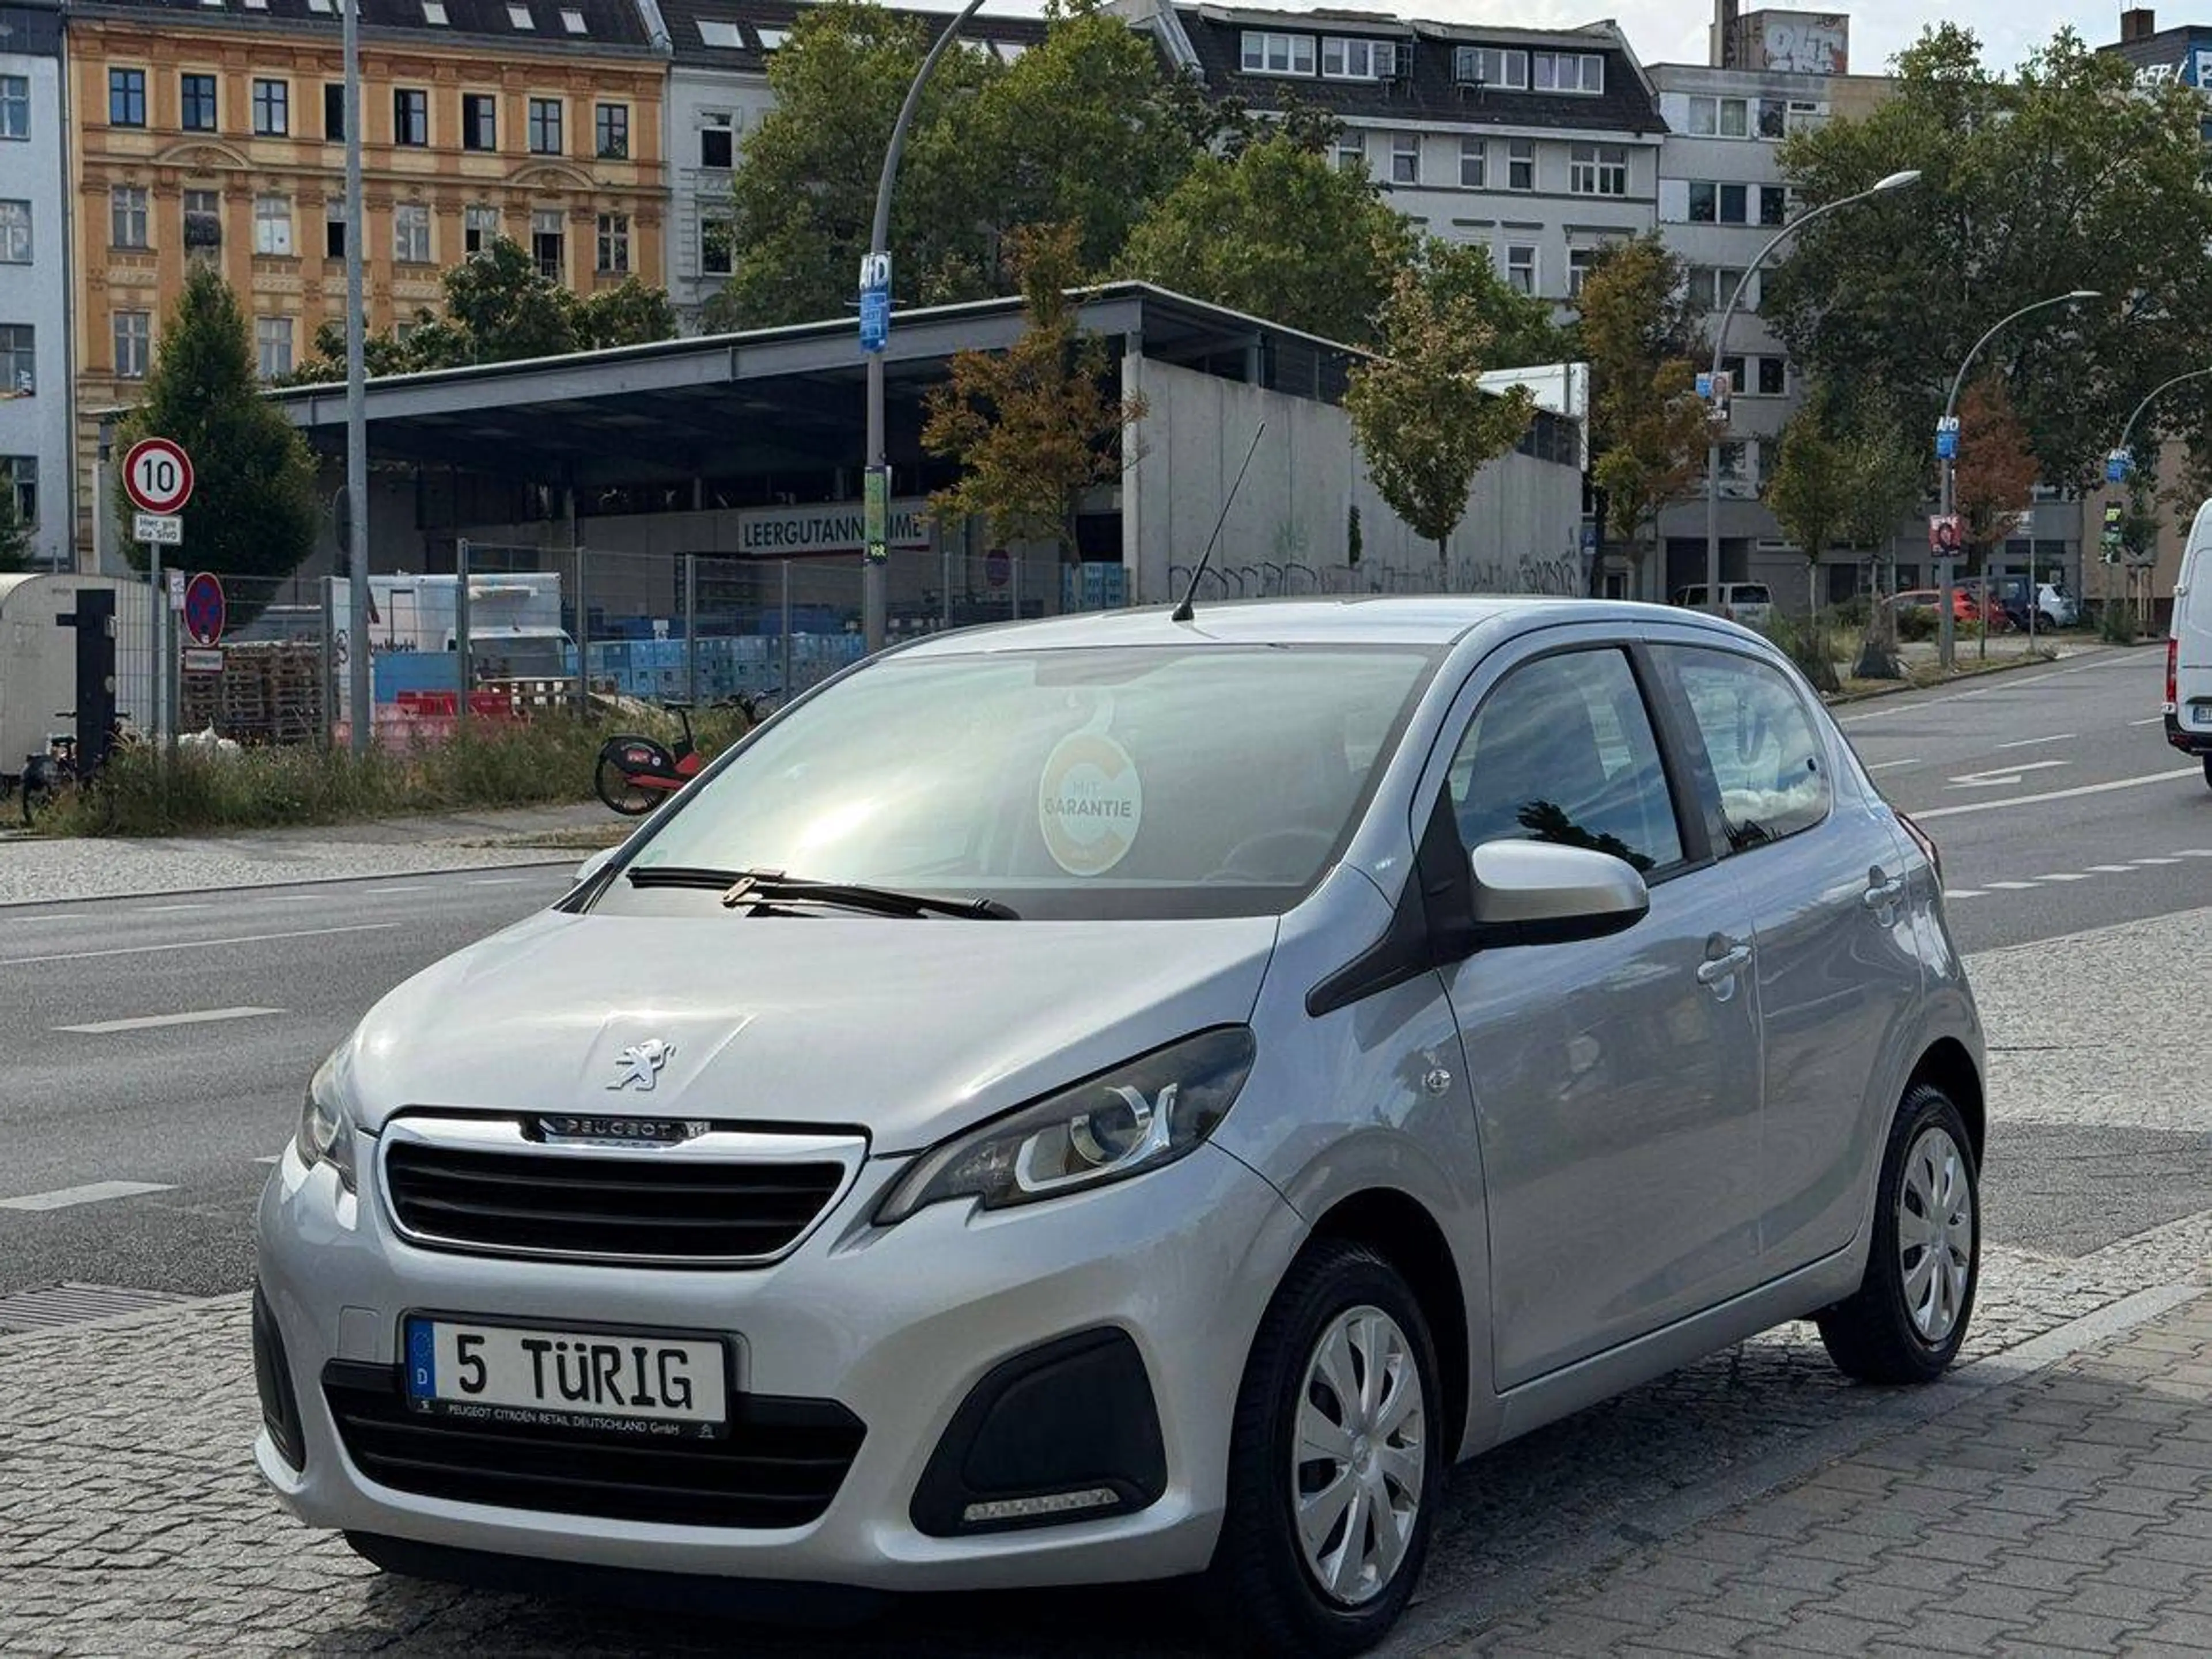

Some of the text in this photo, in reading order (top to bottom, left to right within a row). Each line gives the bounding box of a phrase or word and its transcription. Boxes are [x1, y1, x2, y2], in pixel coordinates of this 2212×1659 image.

[142, 459, 175, 493] 10
[744, 513, 922, 548] LEERGUTANNME
[1043, 798, 1132, 817] GARANTIE
[566, 1118, 671, 1137] PEUGEOT
[416, 1368, 428, 1385] D
[456, 1334, 487, 1394] 5
[448, 1404, 492, 1419] PEUGEOT
[539, 1413, 569, 1427] RETAIL
[571, 1415, 647, 1433] DEUTSCHLAND
[649, 1423, 680, 1436] GmbH
